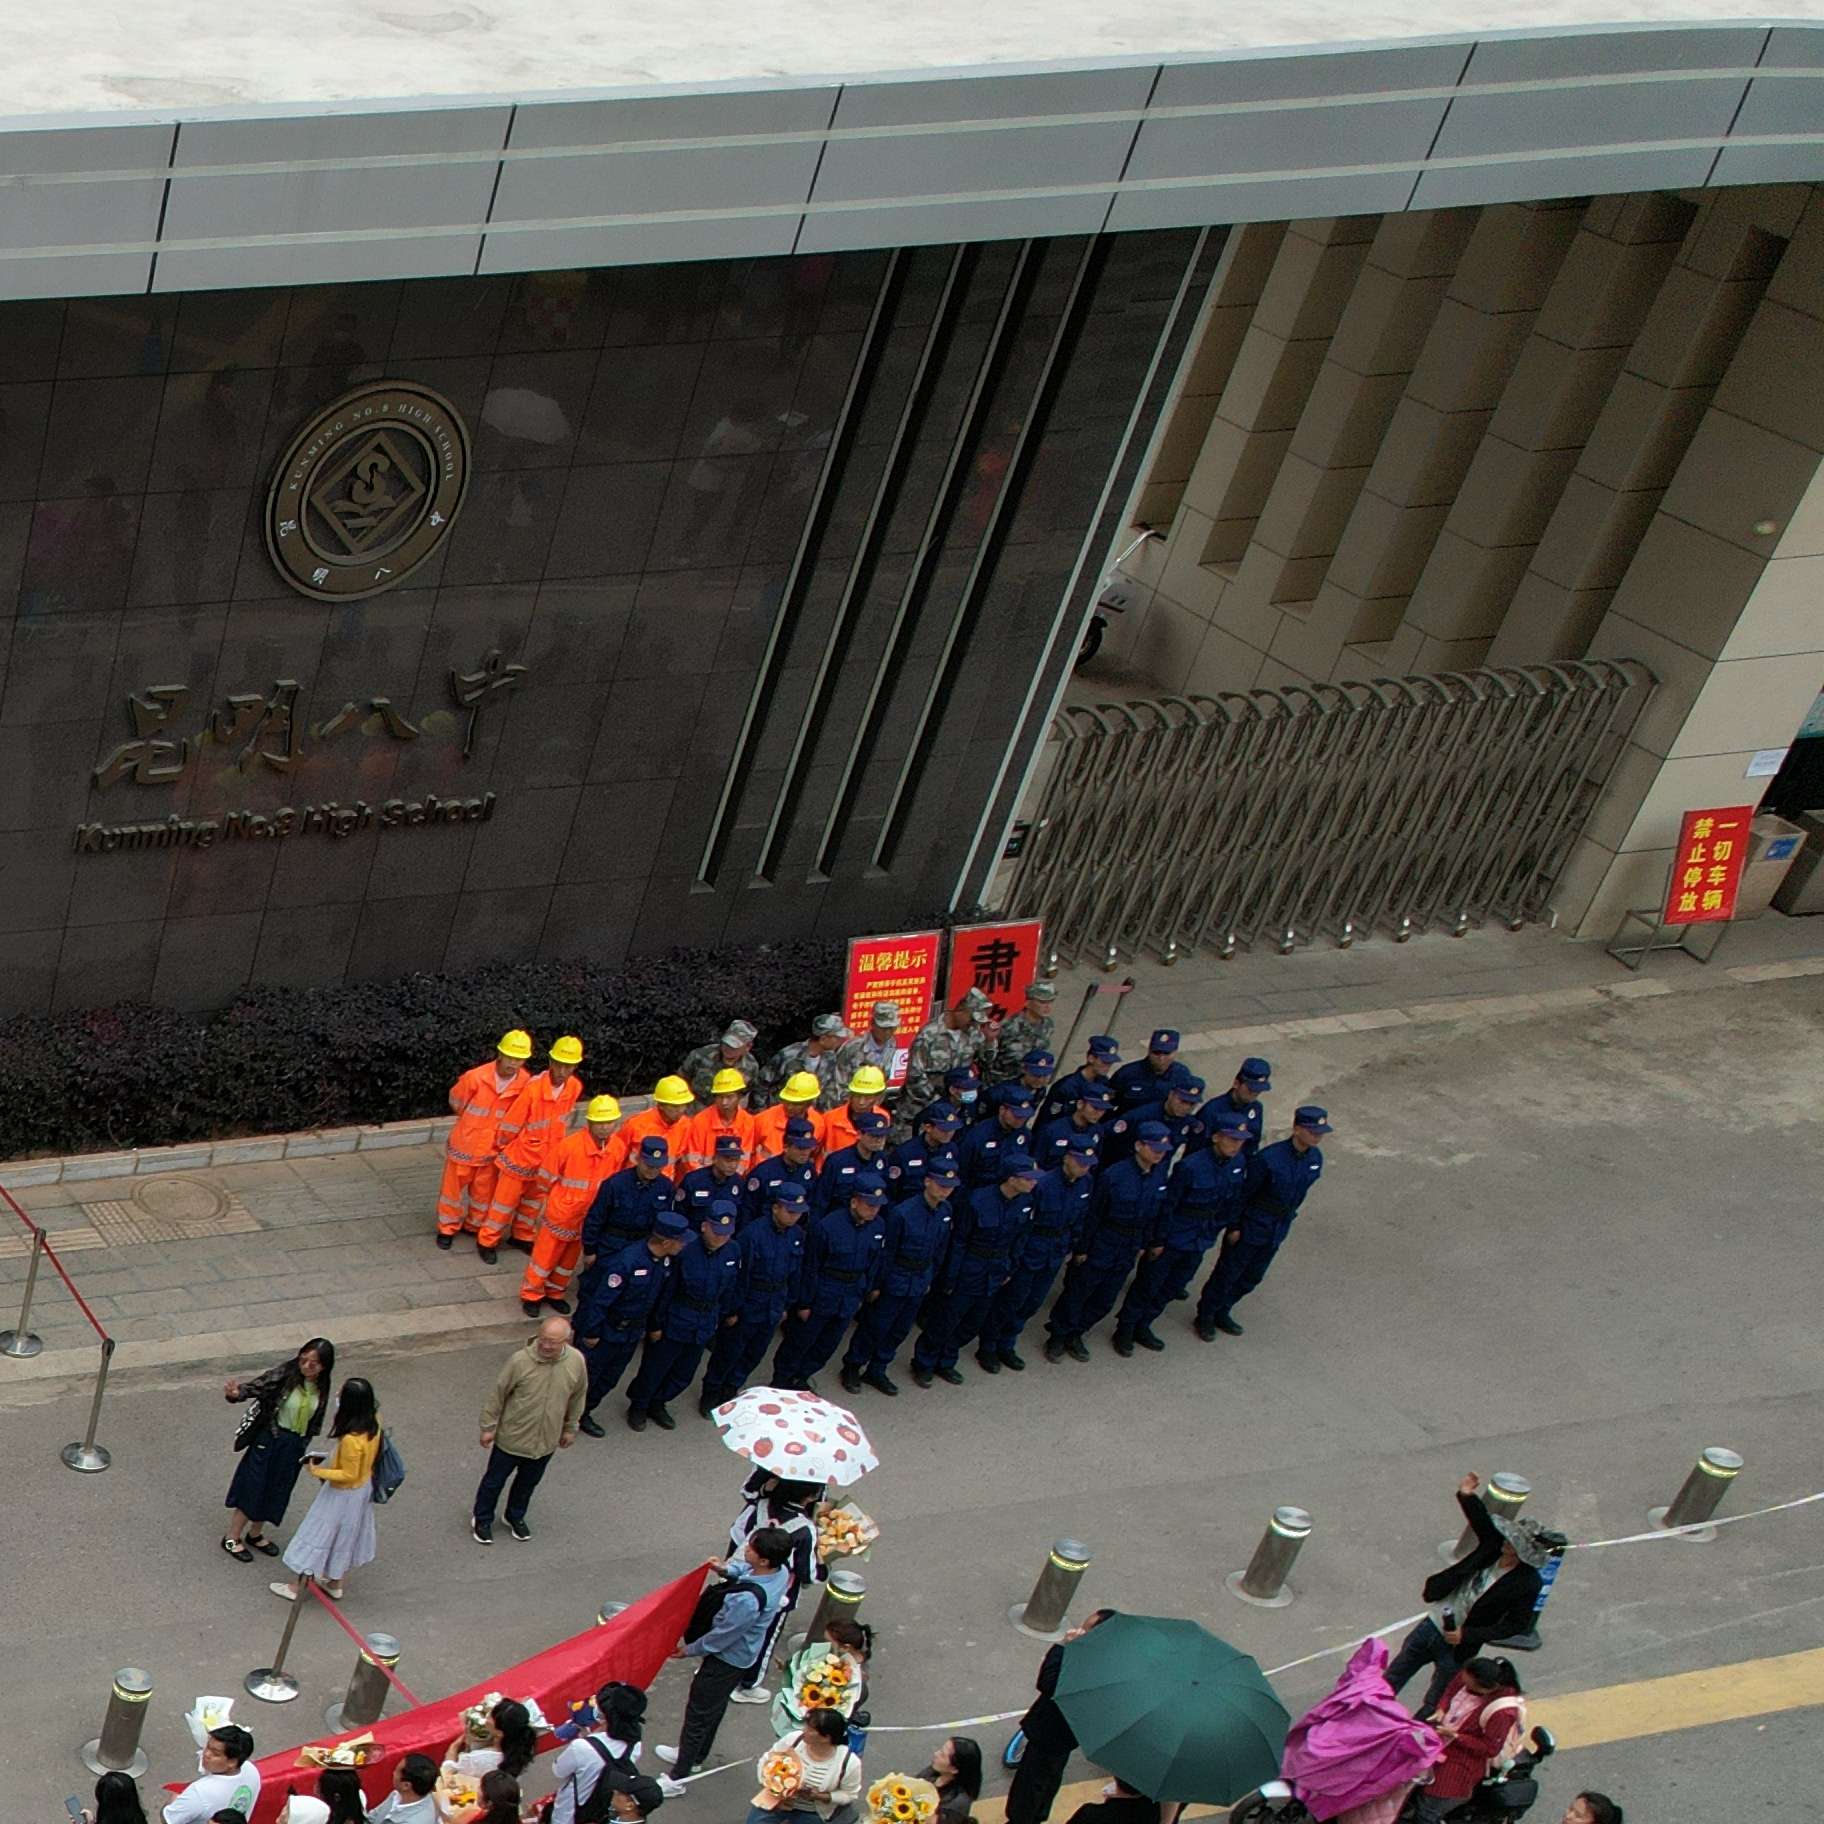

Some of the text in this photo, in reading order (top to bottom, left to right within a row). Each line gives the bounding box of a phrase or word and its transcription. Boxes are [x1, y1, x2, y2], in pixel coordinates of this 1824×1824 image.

[289, 422, 344, 490] KUNMING
[397, 403, 433, 424] HIGH
[434, 425, 455, 481] SCHOOL
[93, 650, 529, 788] 昆明八中
[74, 791, 498, 854] Kunming No.8 High School
[1678, 817, 1714, 912] 禁止停放
[1701, 822, 1739, 911] 一切车辆
[858, 948, 929, 973] 温馨提示
